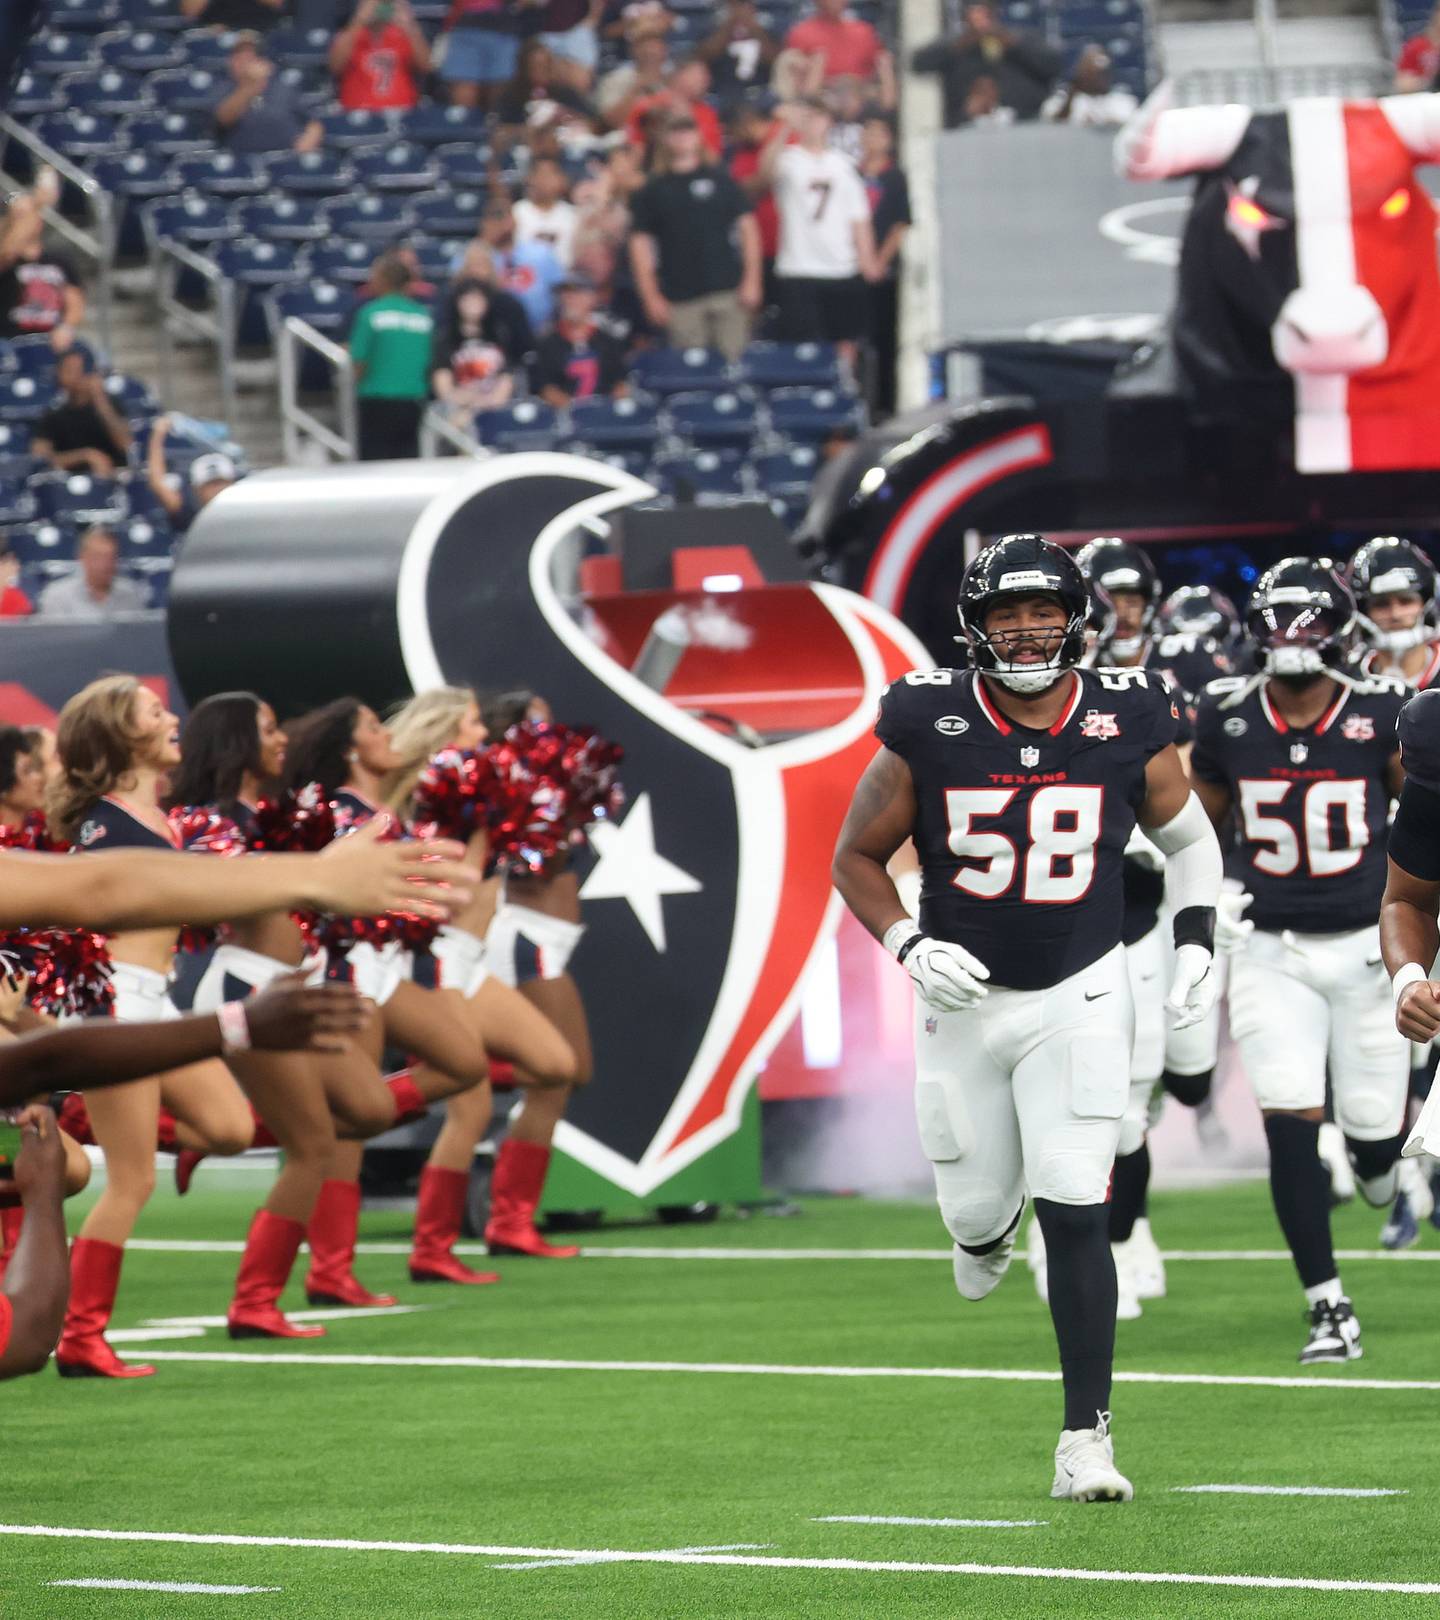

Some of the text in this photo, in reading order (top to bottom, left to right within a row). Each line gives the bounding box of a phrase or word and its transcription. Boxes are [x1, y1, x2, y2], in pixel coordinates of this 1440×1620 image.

[728, 38, 761, 80] 7
[810, 179, 833, 220] 7
[1083, 713, 1119, 737] 25
[988, 771, 1068, 784] TEXANS
[944, 784, 1104, 903] 58
[1238, 776, 1369, 878] 50
